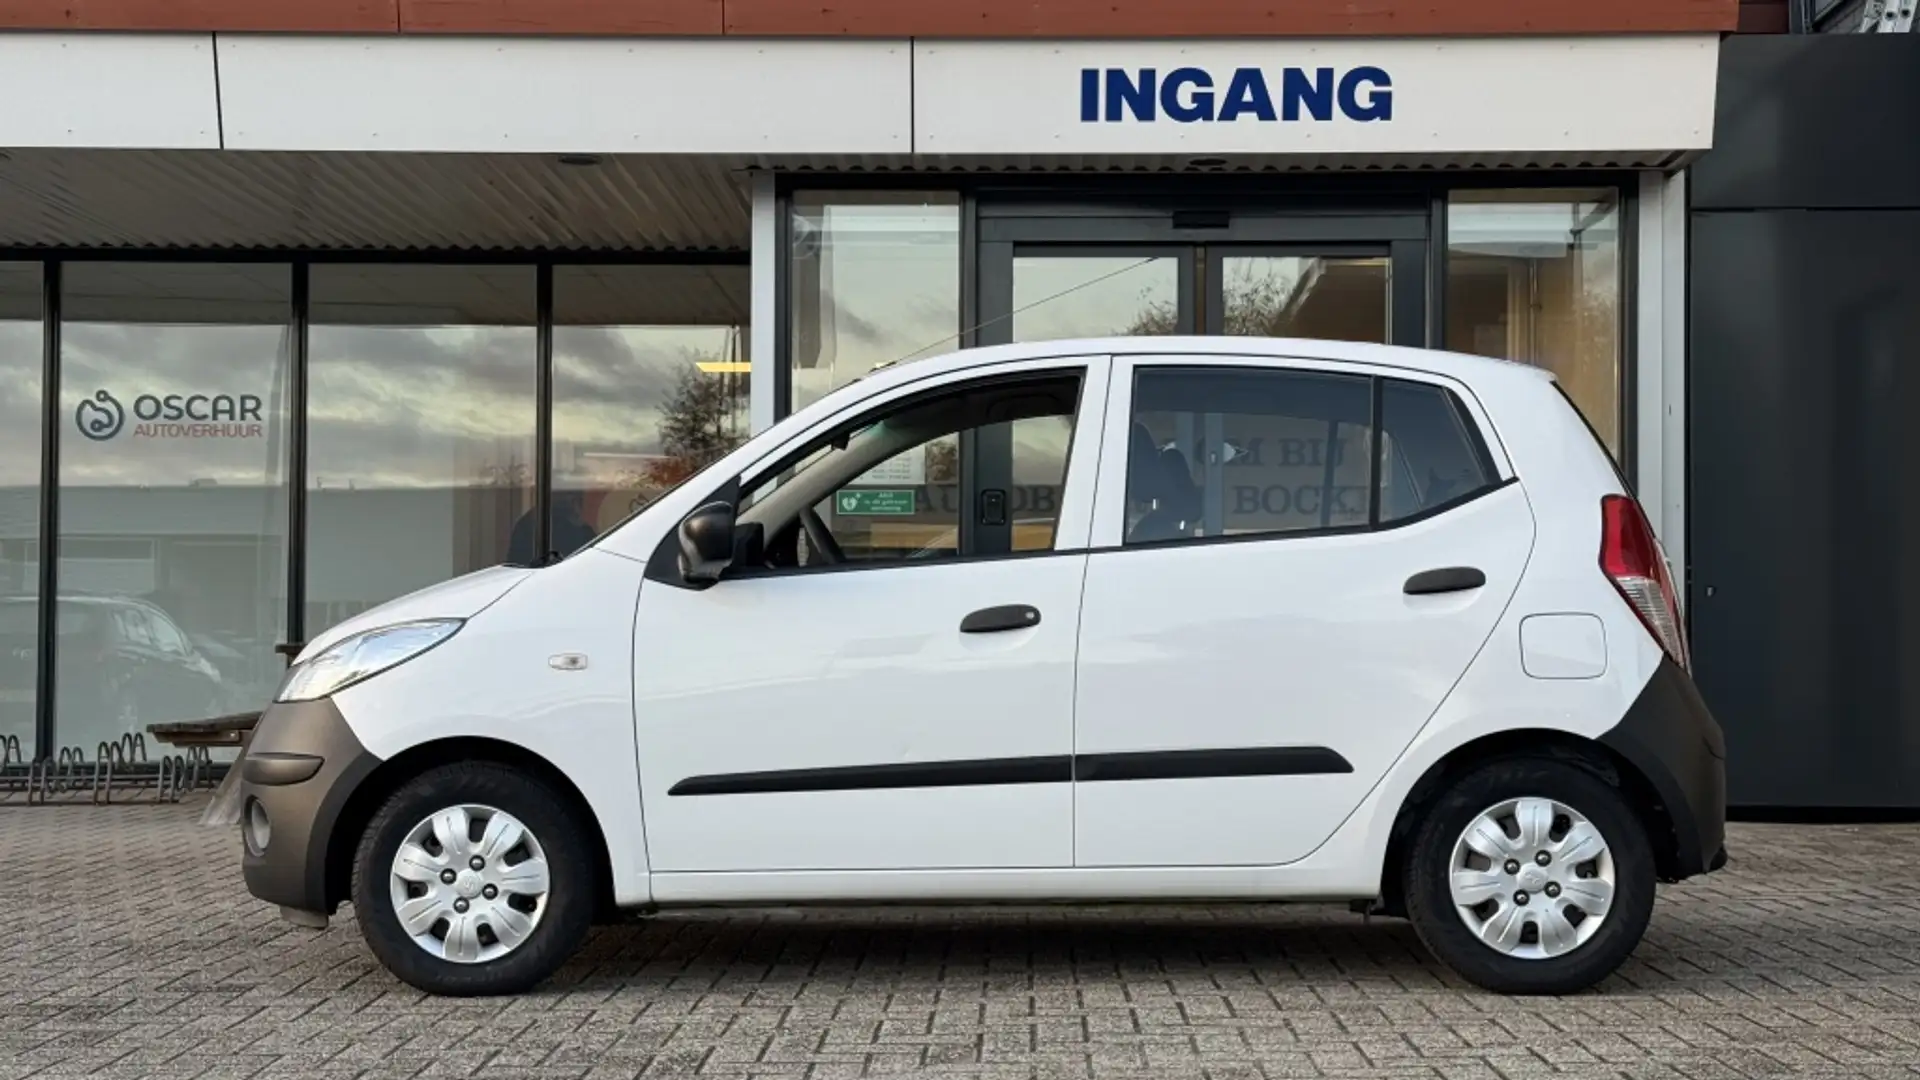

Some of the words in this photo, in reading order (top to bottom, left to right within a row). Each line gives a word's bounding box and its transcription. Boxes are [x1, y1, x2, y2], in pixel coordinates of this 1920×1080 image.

[1080, 66, 1393, 122] INGANG
[133, 394, 262, 421] OSCAR
[133, 423, 262, 438] AUTOVERHUUR
